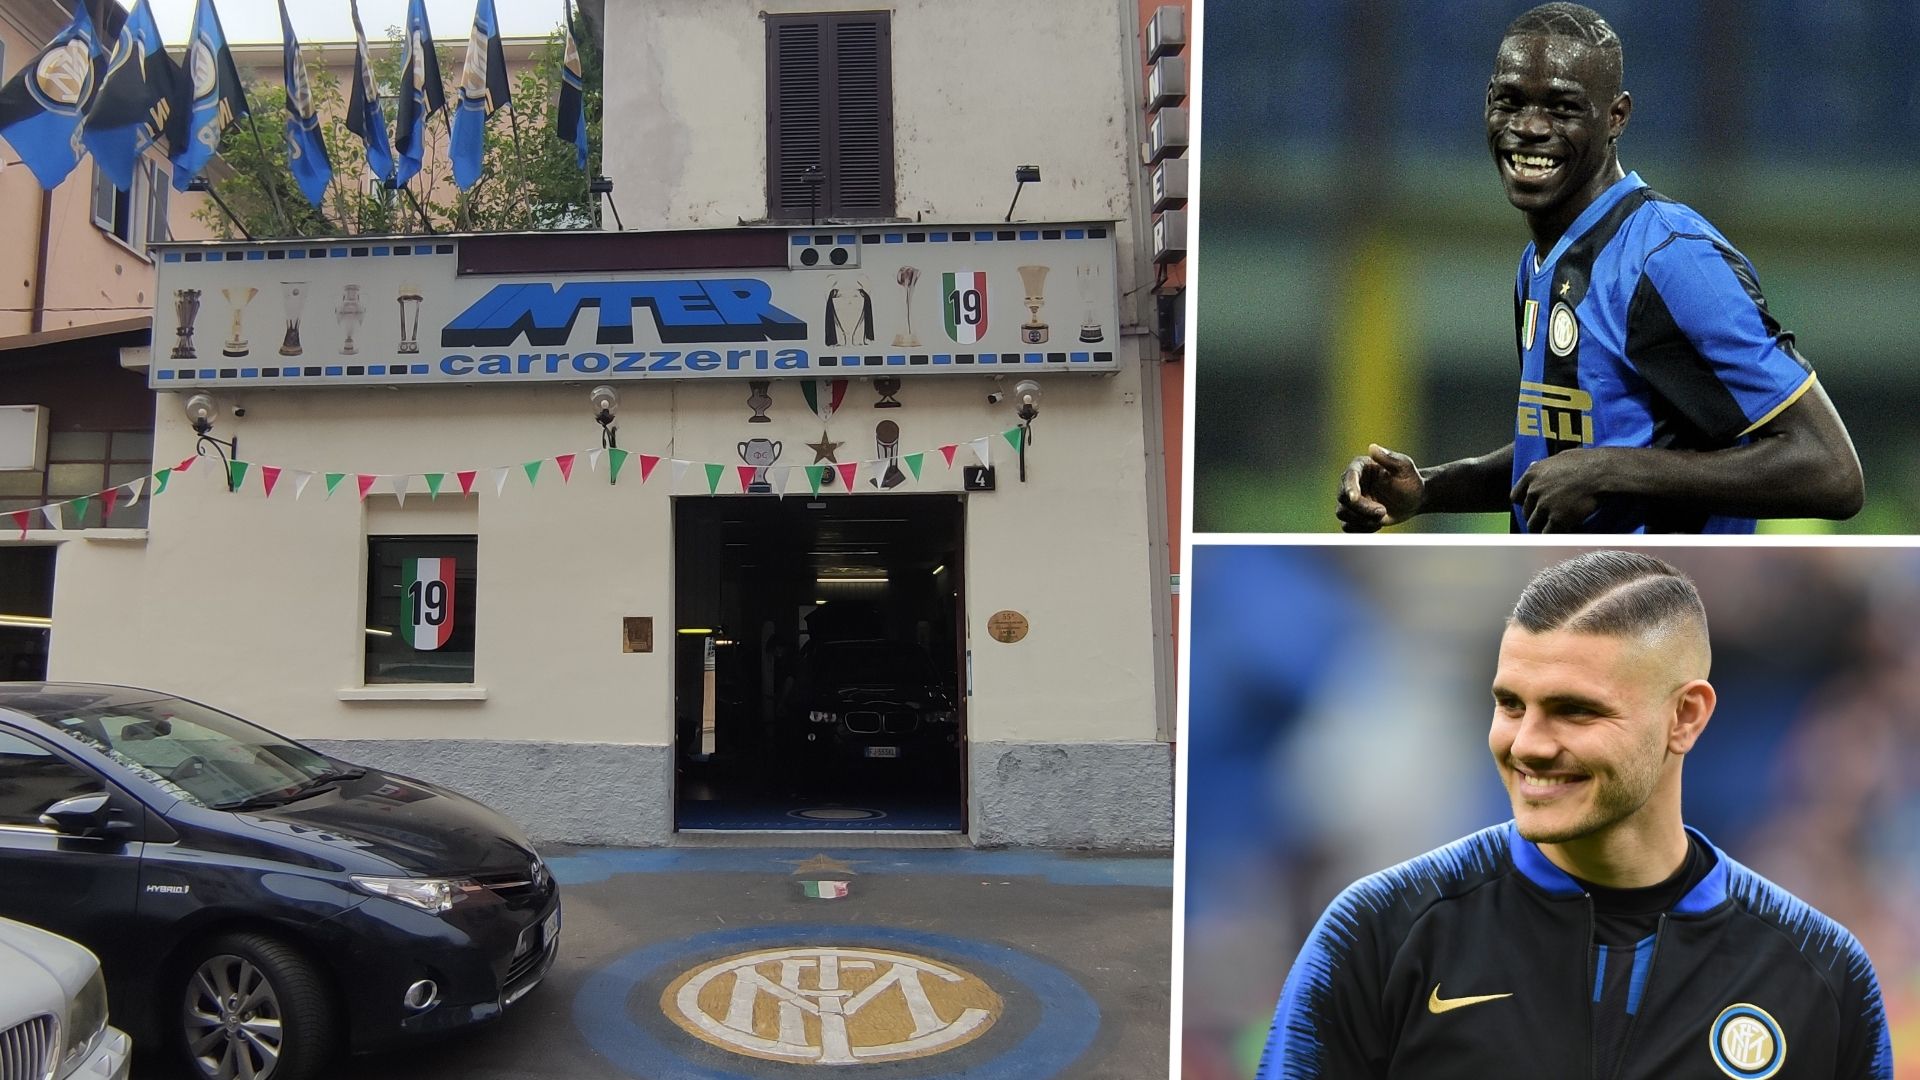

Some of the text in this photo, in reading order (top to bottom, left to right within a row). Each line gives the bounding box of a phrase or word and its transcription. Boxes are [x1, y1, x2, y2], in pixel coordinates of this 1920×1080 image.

[1149, 22, 1165, 256] INTER
[441, 279, 808, 347] INTER
[948, 289, 982, 325] 19
[439, 348, 809, 375] carrozzeria
[974, 470, 987, 487] 4
[408, 580, 448, 626] 19
[146, 885, 183, 894] HYBRID
